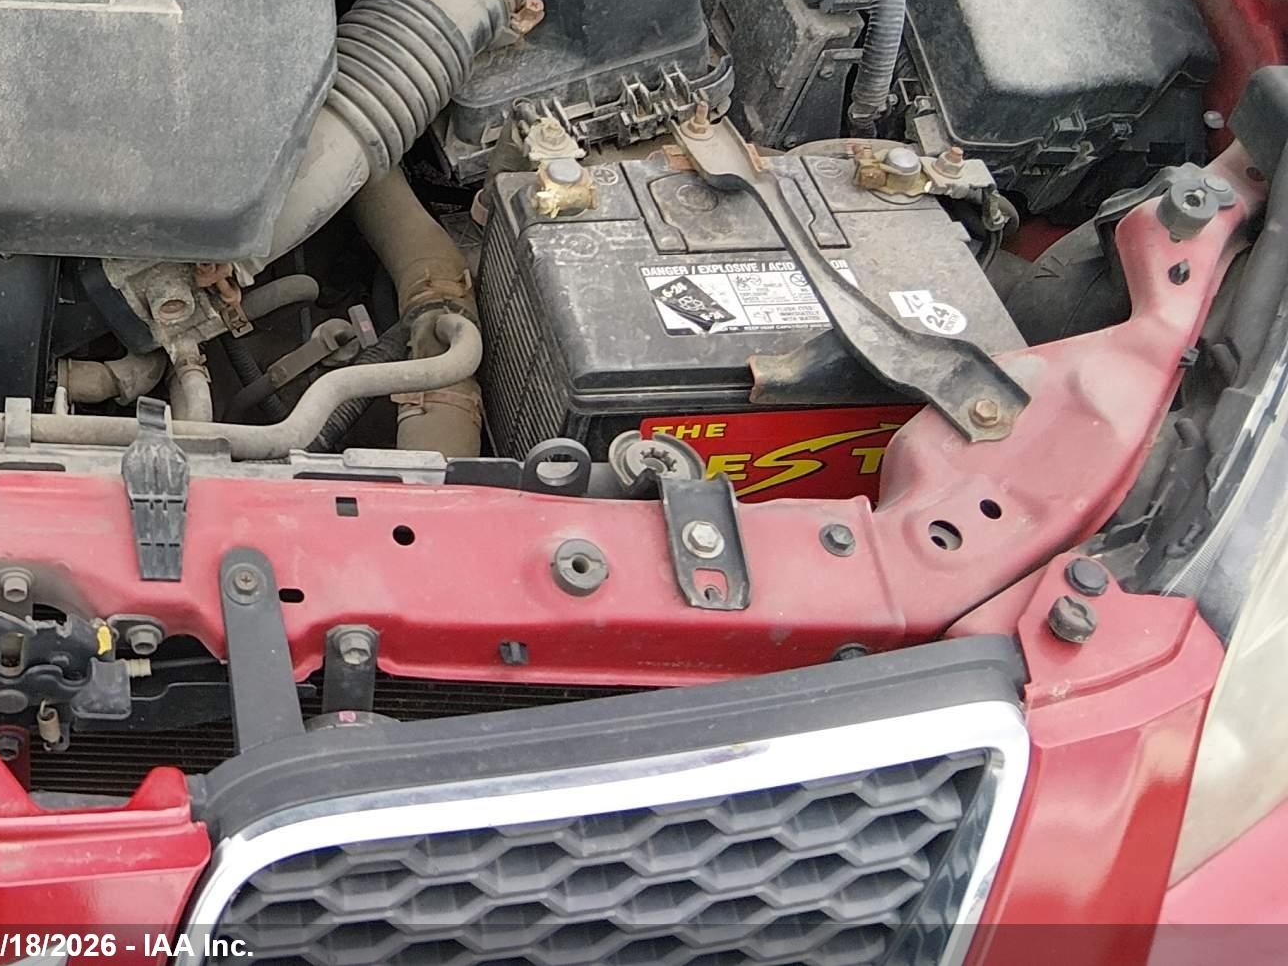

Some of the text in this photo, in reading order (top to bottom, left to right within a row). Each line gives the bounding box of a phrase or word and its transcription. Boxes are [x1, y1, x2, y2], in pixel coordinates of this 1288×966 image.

[641, 266, 689, 276] DANGER
[697, 262, 758, 274] EXPLOSIVE
[768, 261, 796, 272] ACID
[925, 305, 951, 329] 24
[652, 423, 727, 439] THE
